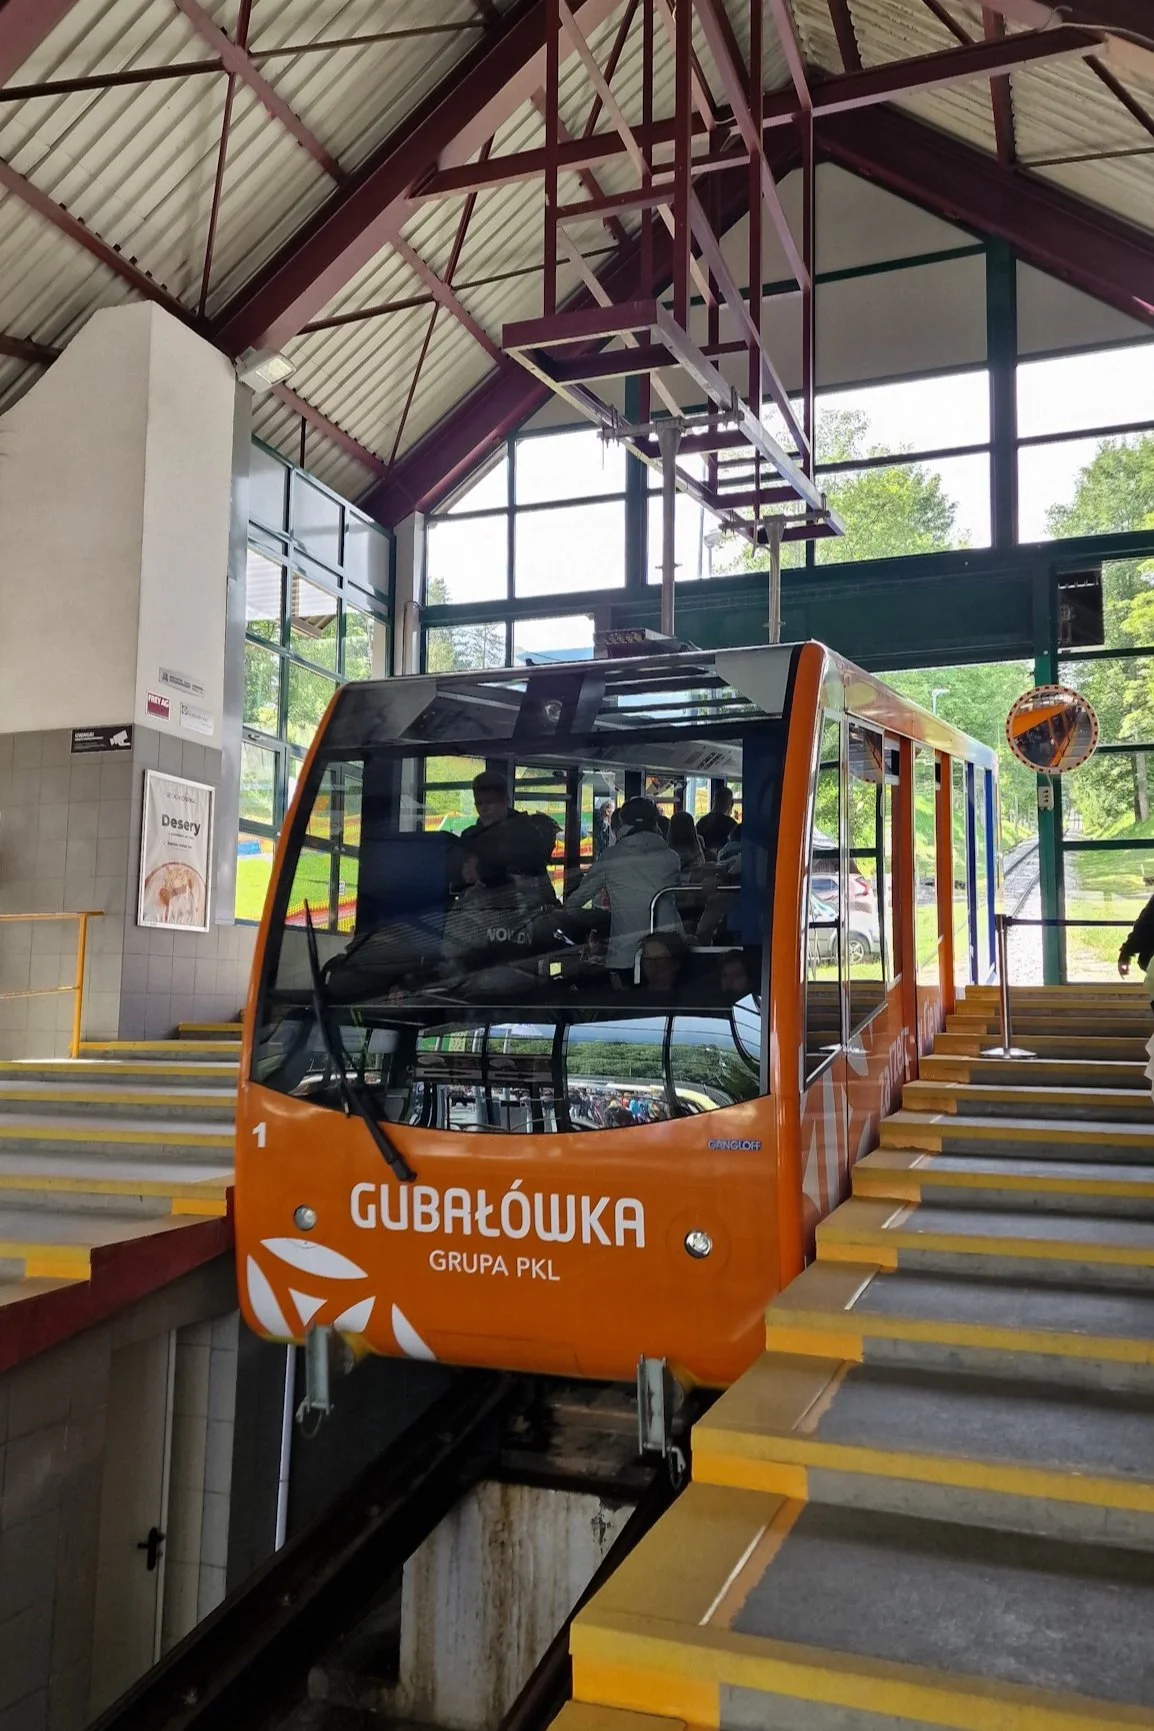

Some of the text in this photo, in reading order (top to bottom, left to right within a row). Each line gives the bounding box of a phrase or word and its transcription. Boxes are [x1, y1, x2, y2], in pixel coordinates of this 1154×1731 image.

[161, 813, 201, 836] Desery
[252, 1121, 267, 1148] 1
[350, 1179, 646, 1249] GUBAŁÓWKA
[429, 1250, 561, 1282] GRUPA PKL
